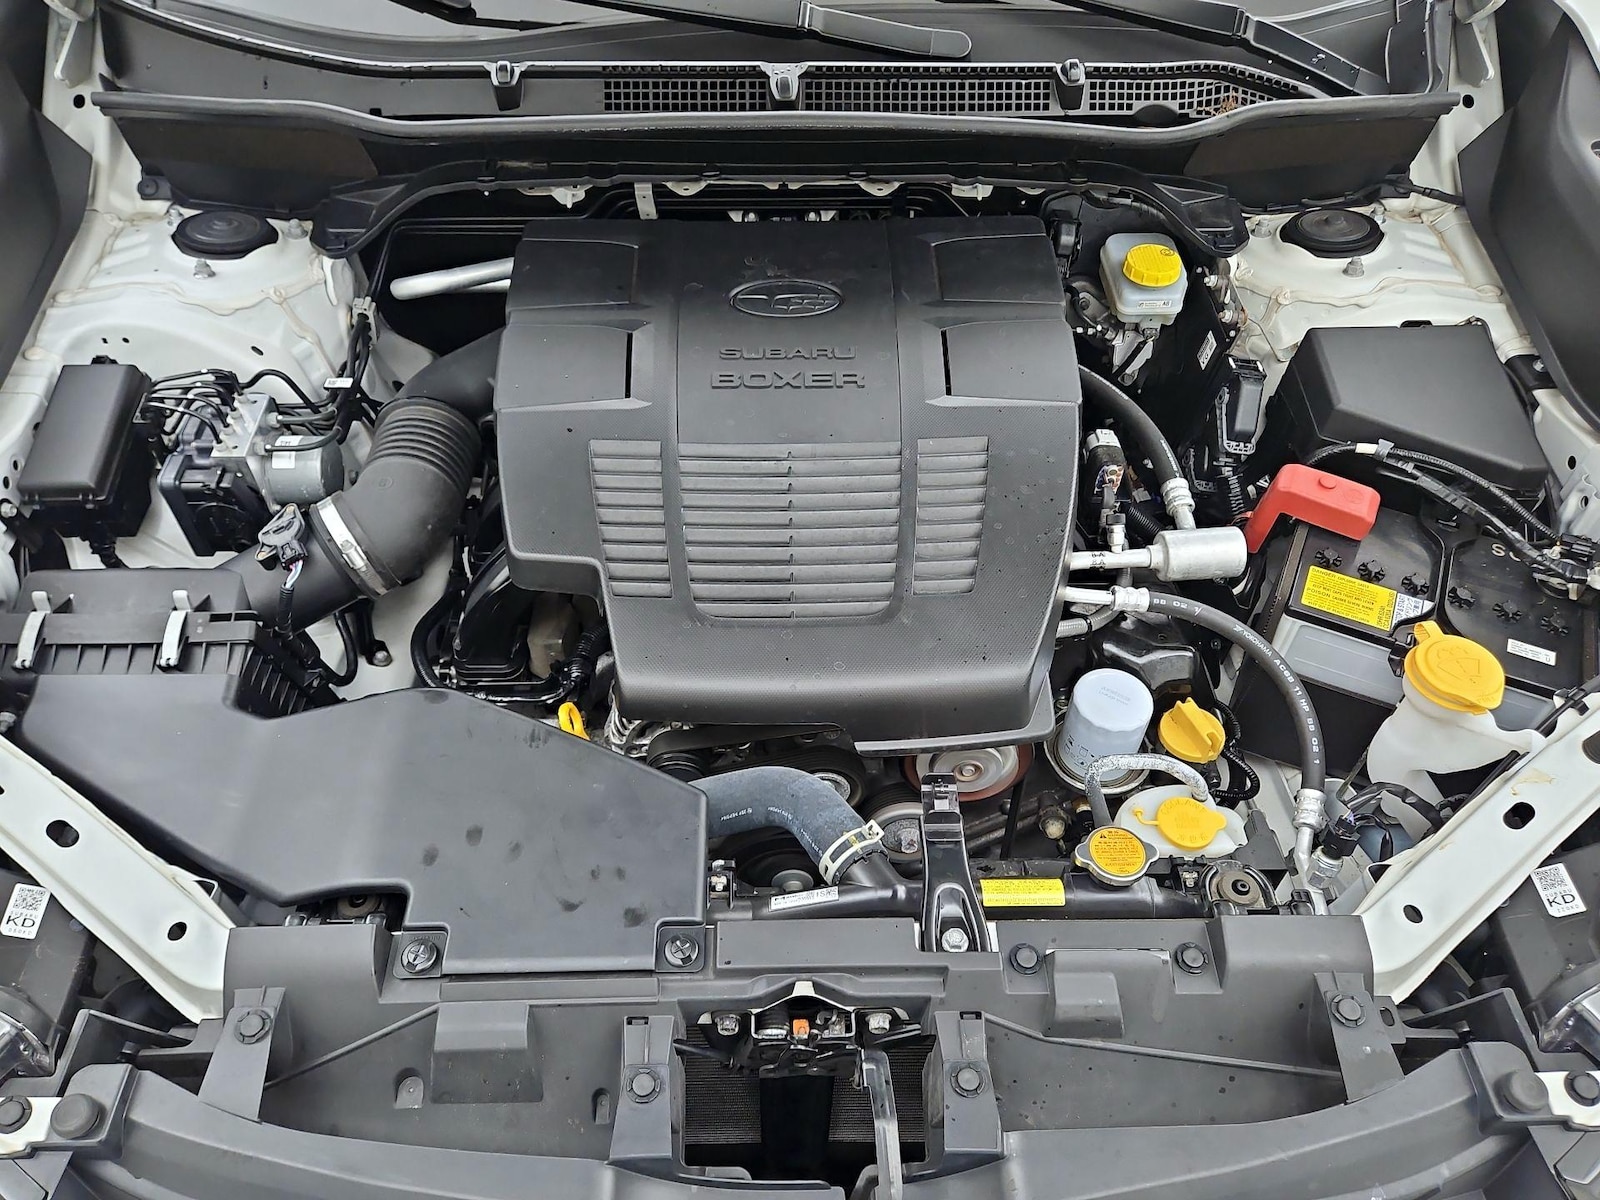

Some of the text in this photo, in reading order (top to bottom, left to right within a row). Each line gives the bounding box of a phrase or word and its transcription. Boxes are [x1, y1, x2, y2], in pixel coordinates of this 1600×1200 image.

[719, 347, 857, 360] SUBARU
[711, 371, 866, 390] BOXER
[1300, 699, 1310, 712] HP
[1547, 894, 1576, 908] KD
[6, 916, 36, 928] KD
